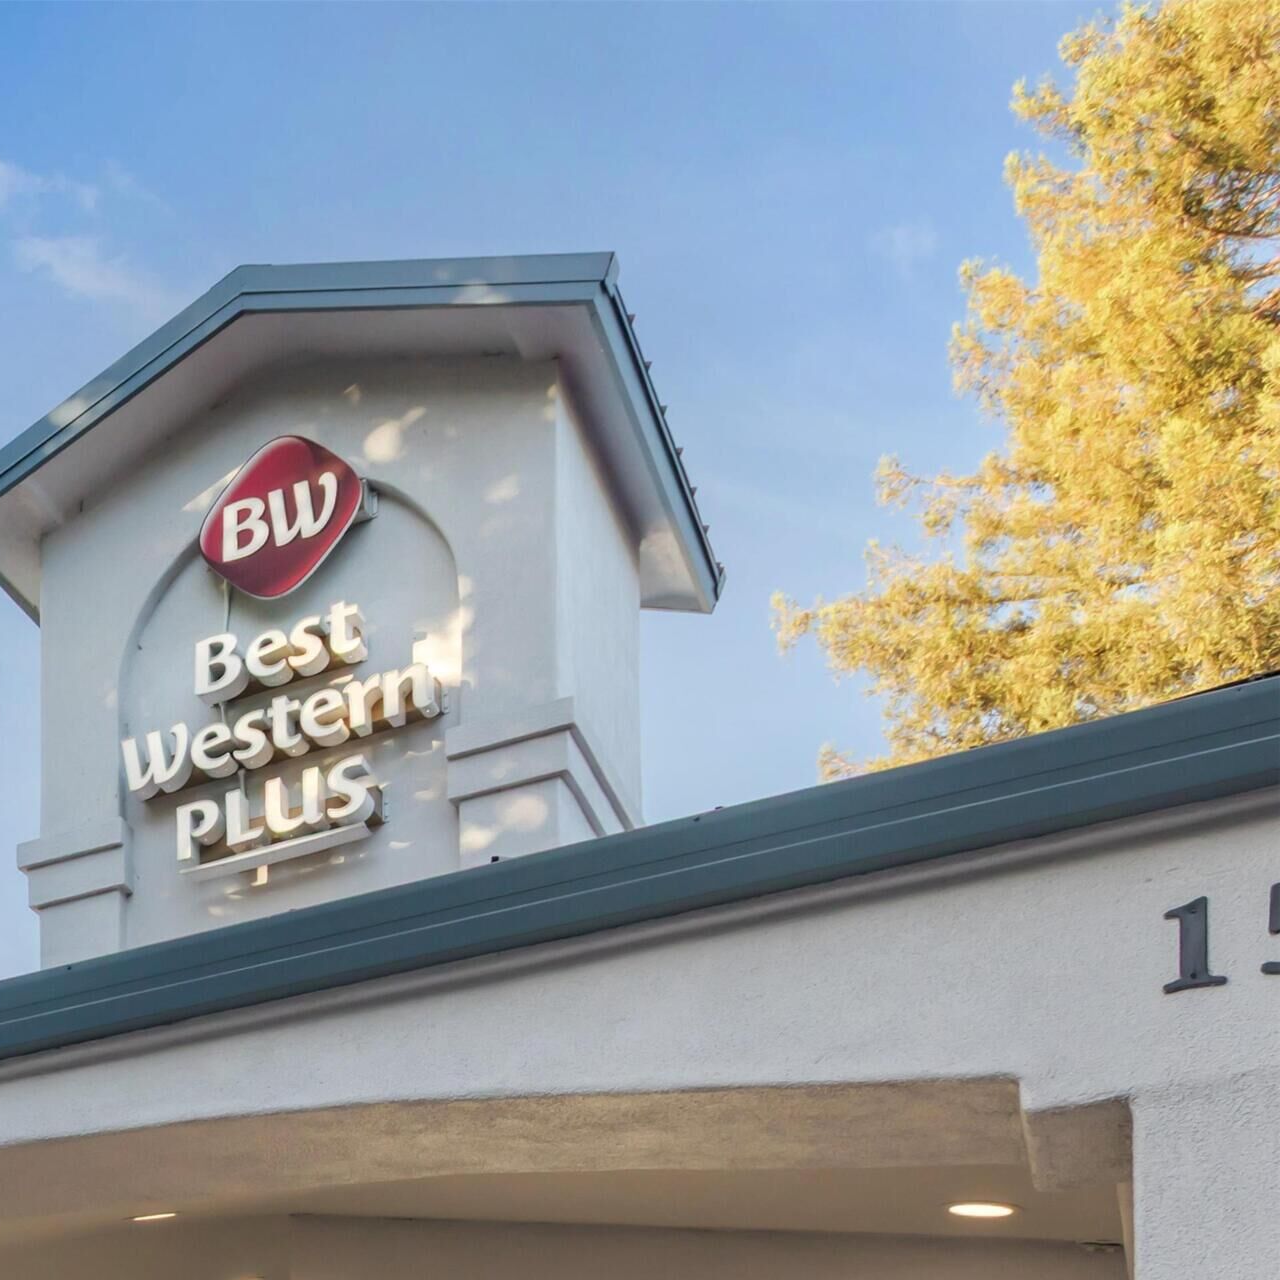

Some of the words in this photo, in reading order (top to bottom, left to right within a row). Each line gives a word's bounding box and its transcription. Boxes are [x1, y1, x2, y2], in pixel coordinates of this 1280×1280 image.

[222, 471, 338, 562] BW
[194, 600, 368, 703] Best
[120, 662, 446, 800] Western
[176, 754, 378, 862] PLUS
